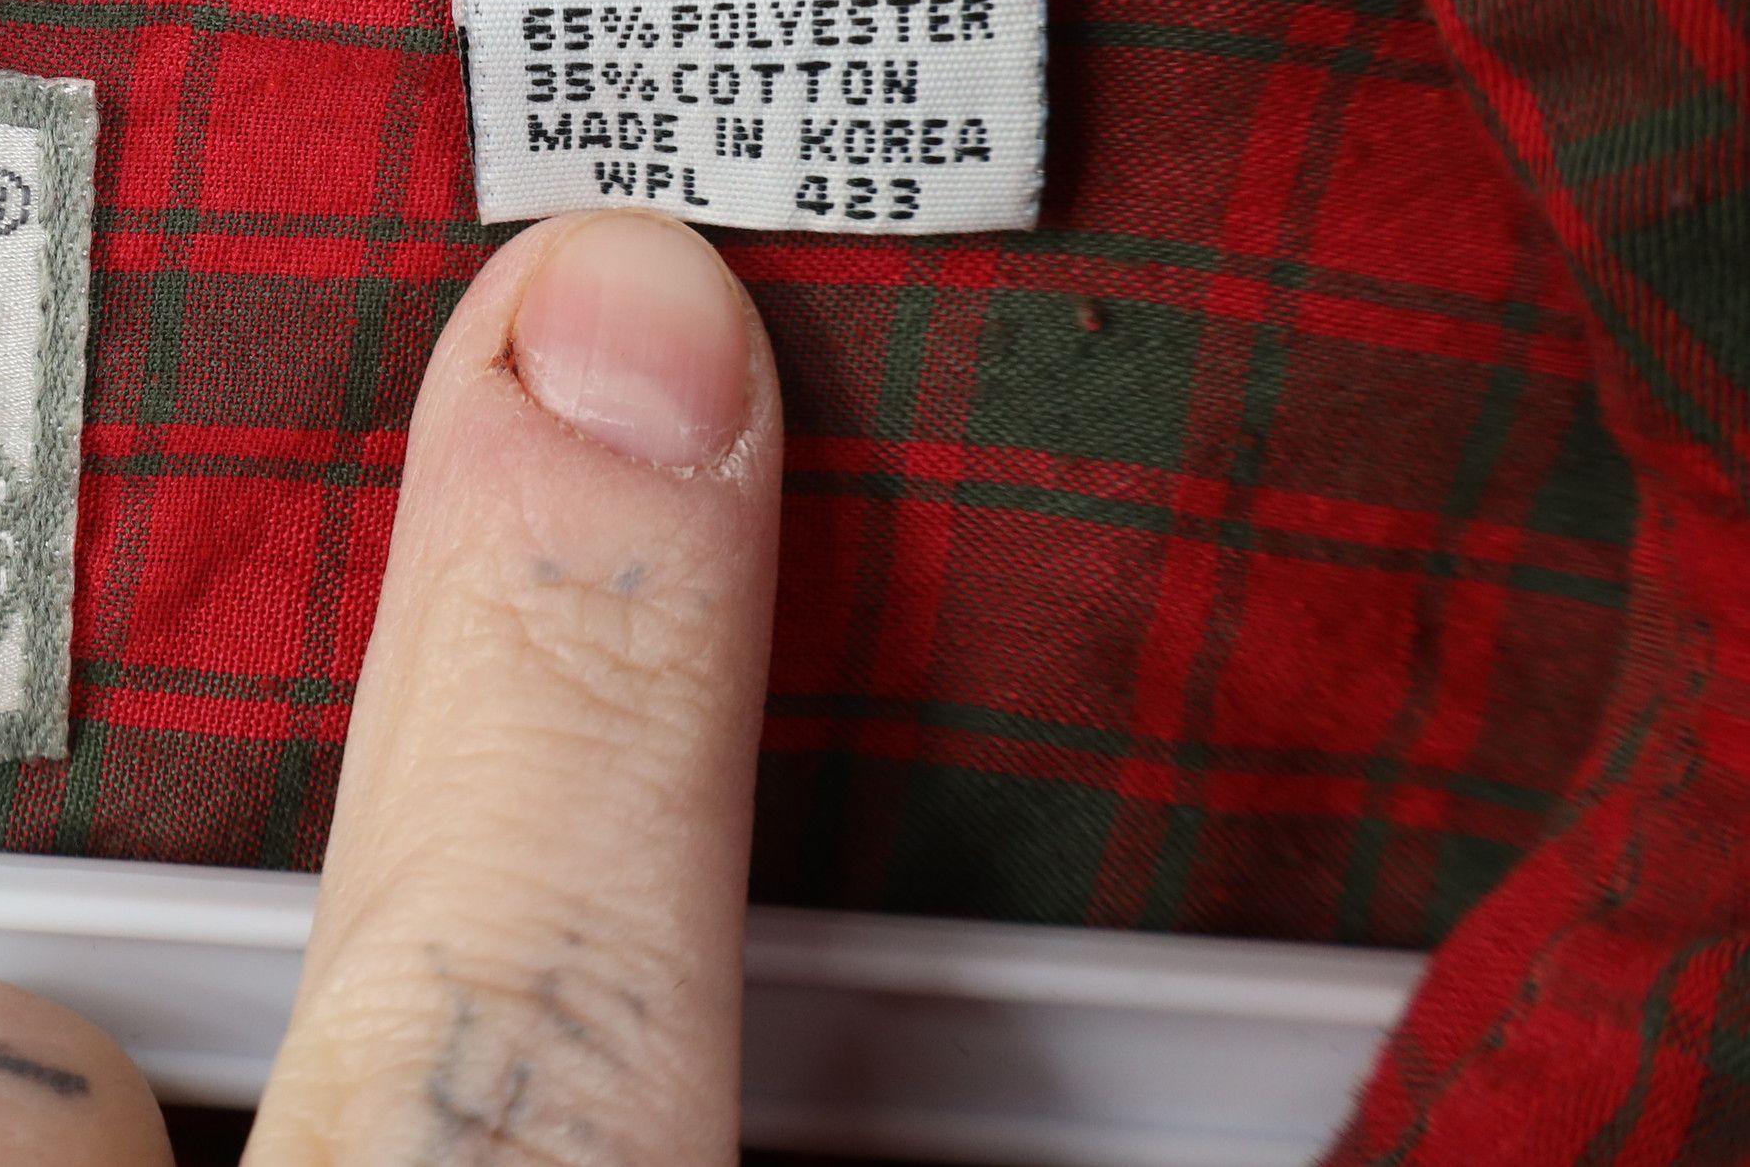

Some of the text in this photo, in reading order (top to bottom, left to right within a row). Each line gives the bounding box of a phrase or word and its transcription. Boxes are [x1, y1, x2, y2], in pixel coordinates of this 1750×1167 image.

[527, 111, 992, 166] MADE IN KOREA
[594, 161, 921, 221] WPL 423
